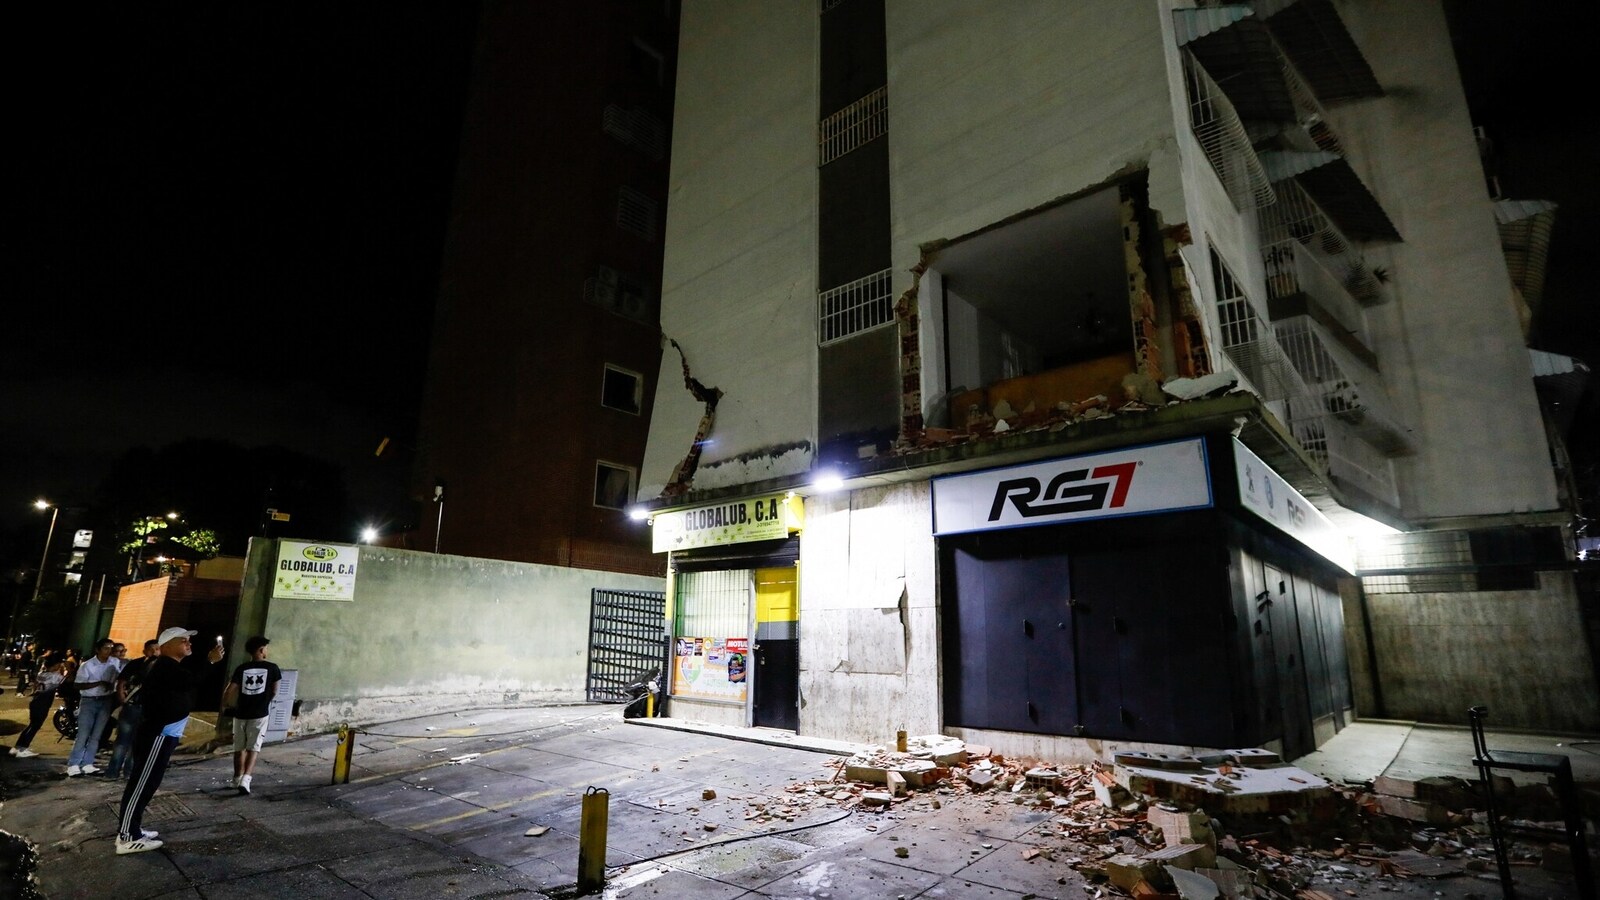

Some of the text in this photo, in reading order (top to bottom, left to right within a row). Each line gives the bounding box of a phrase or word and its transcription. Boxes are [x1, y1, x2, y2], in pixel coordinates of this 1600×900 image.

[988, 461, 1138, 522] RG7
[685, 498, 778, 531] GLOBALUB, C.A
[280, 559, 354, 575] GLOBALUB, C.A
